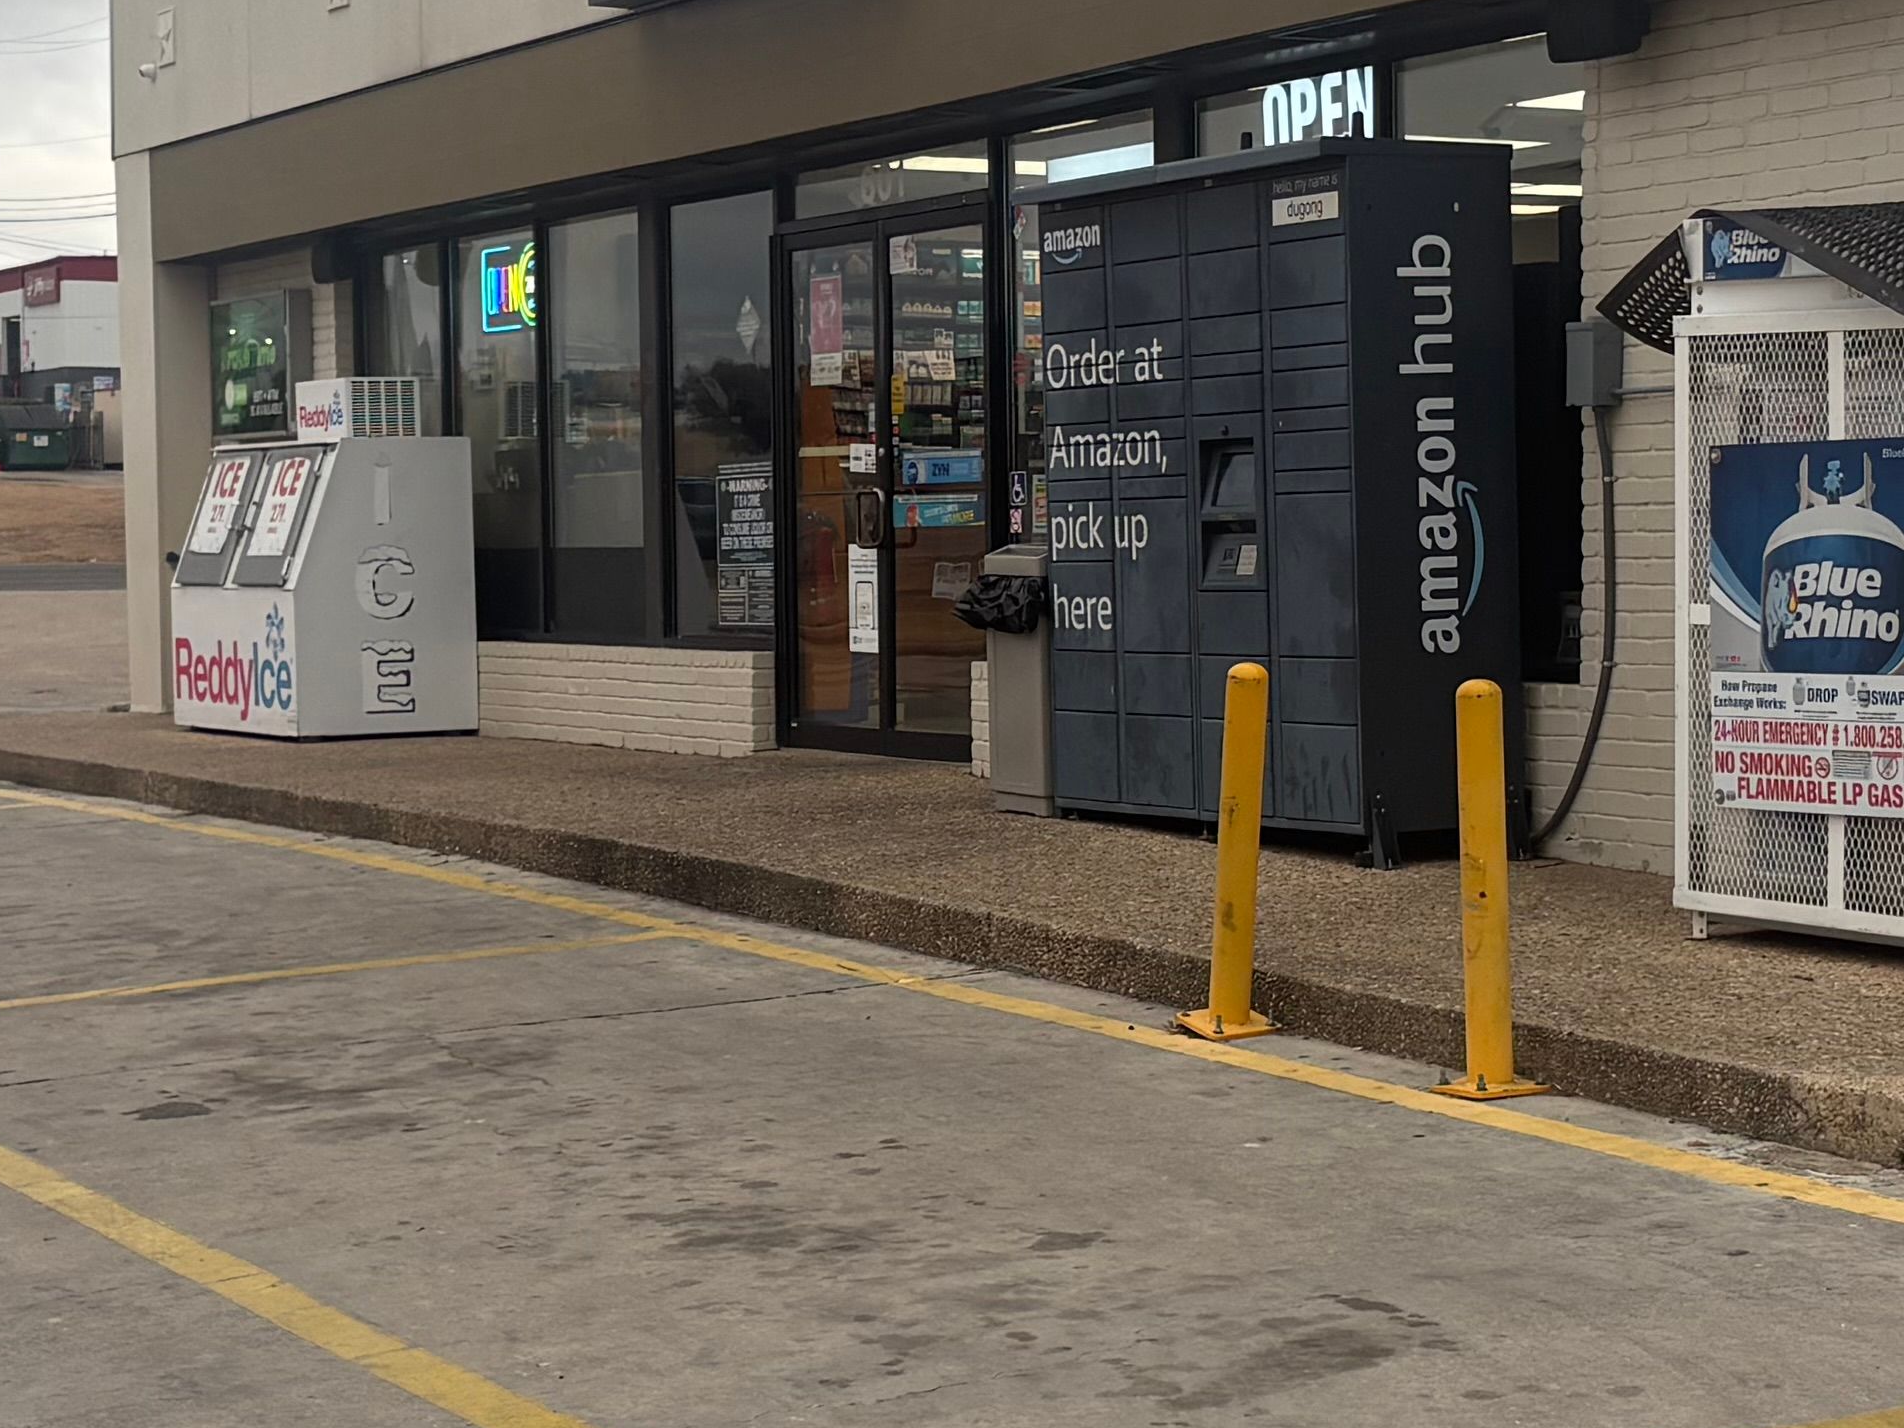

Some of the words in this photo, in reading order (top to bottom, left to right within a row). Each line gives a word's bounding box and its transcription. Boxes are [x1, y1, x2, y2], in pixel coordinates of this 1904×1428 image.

[1262, 65, 1374, 147] OPEN
[1286, 199, 1323, 221] dugong
[1043, 224, 1101, 253] amazon
[1396, 234, 1454, 374] hub
[1046, 338, 1125, 390] Order
[1134, 337, 1164, 382] at
[1049, 425, 1168, 474] Amazon,
[213, 462, 245, 498] ICE
[272, 459, 306, 497] ICE
[1051, 501, 1104, 561] pick
[1115, 512, 1149, 561] up
[1416, 396, 1461, 654] amazon
[1794, 560, 1882, 598] Blue
[1053, 583, 1113, 631] here
[1784, 599, 1900, 643] Rhino
[1714, 695, 1754, 710] Exchange
[1756, 696, 1787, 710] Works:
[1721, 680, 1740, 692] How
[1742, 680, 1778, 695] Propane
[1807, 687, 1839, 703] DROP
[1714, 719, 1760, 743] 24-HOUR
[1763, 722, 1829, 746] EMERGENCY
[1714, 750, 1735, 774] NO
[1739, 752, 1813, 778] SMOKING
[1737, 776, 1837, 805] FLAMMABLE
[1842, 780, 1864, 806] LP
[1867, 782, 1904, 809] GAS
